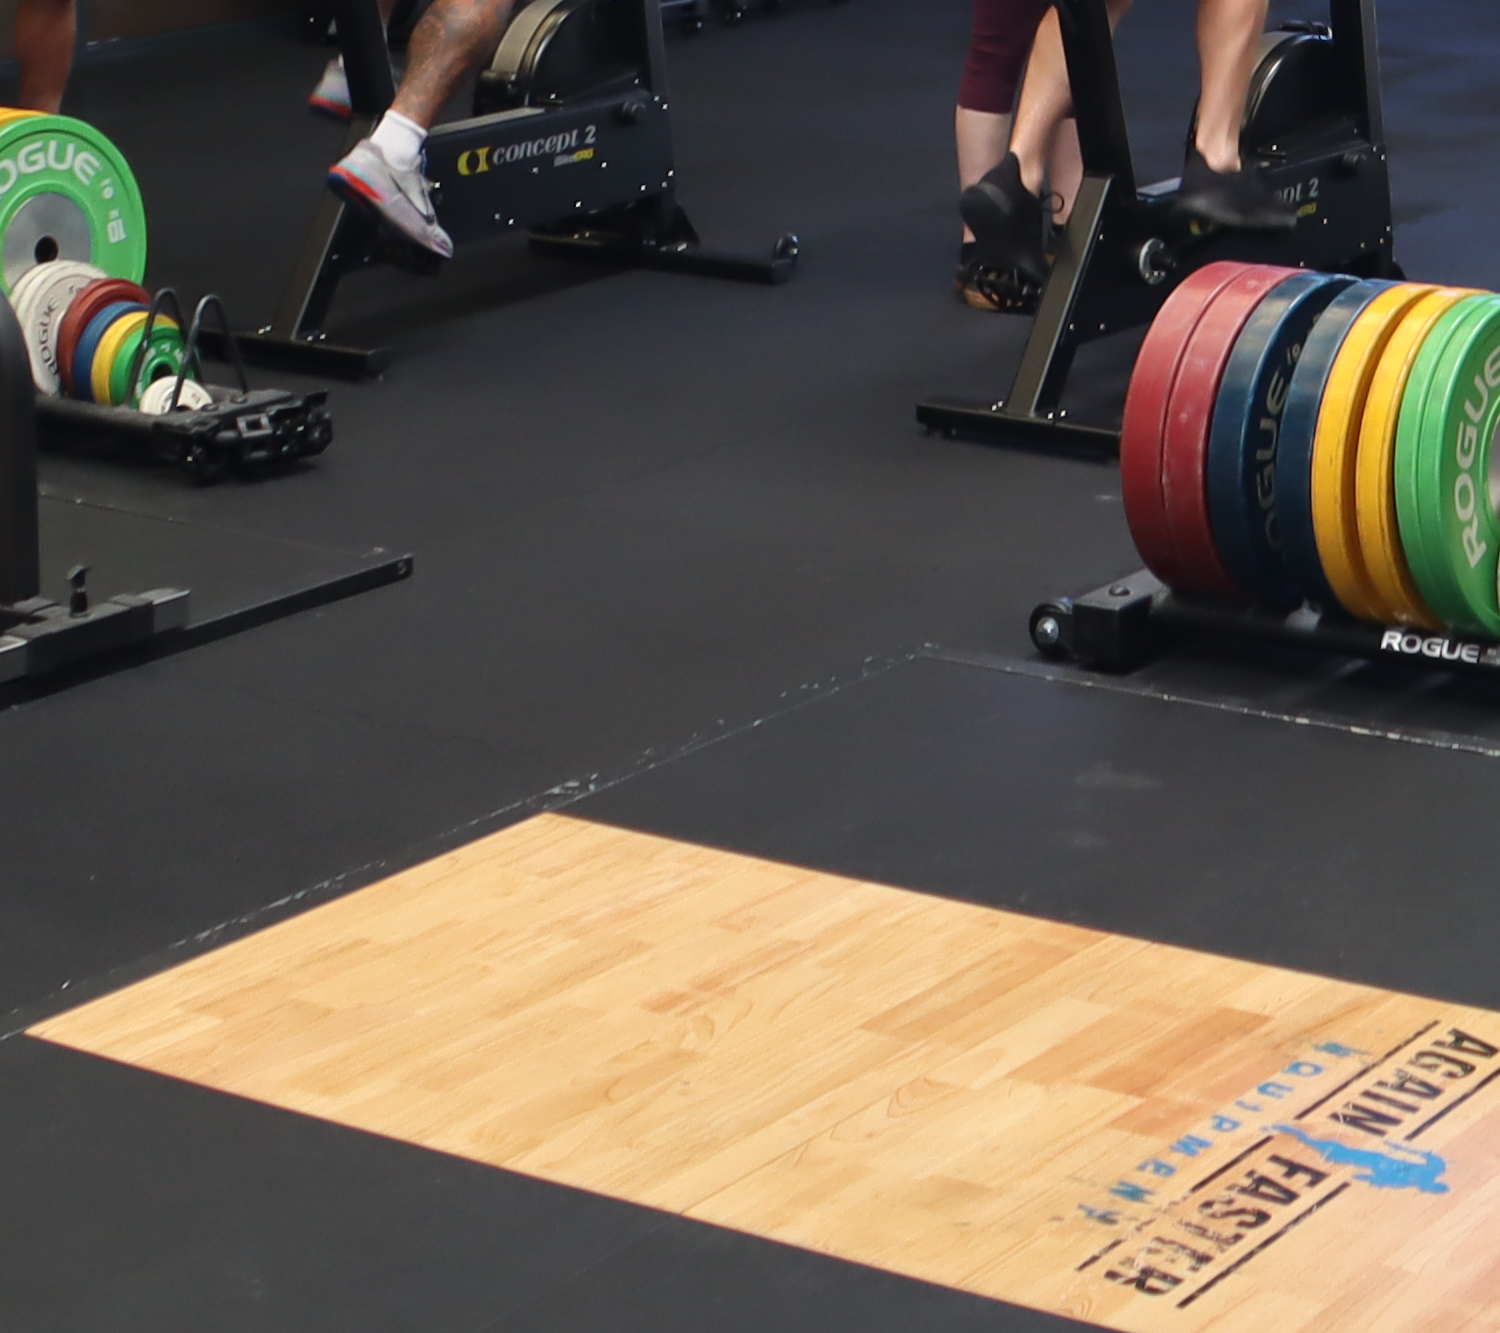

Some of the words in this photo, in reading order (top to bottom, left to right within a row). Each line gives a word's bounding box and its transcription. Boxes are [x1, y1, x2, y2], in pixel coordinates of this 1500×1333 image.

[491, 129, 580, 165] concept
[584, 124, 597, 144] 2
[1380, 630, 1480, 664] ROGUE
[1328, 1027, 1500, 1139] AGAIN
[1102, 1151, 1331, 1298] FASTER
